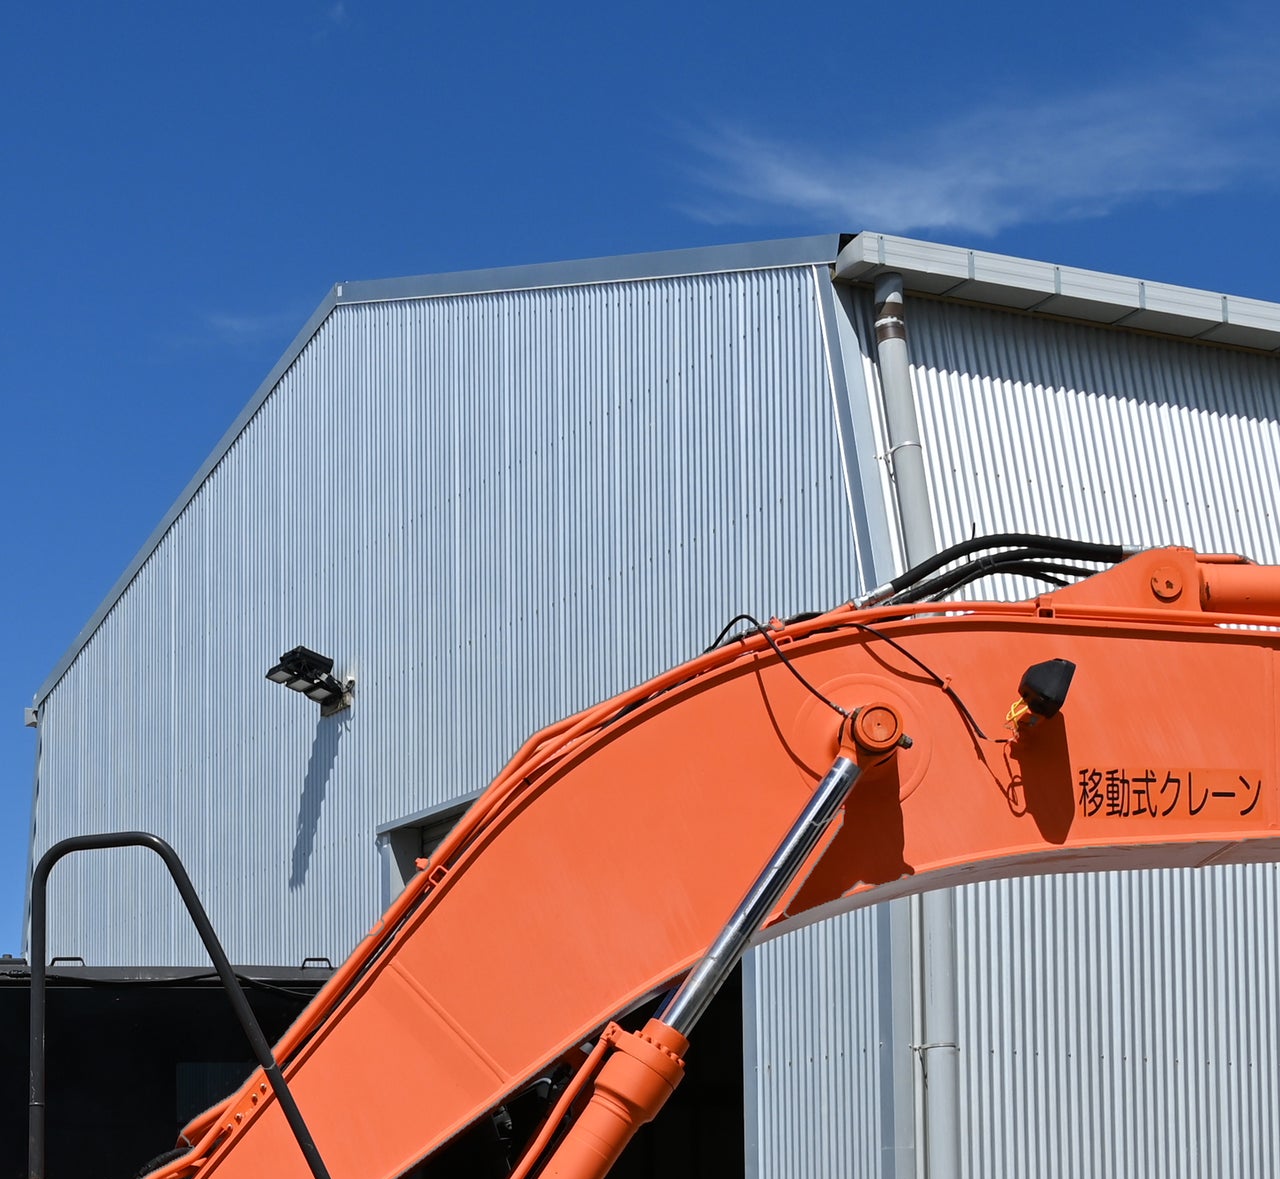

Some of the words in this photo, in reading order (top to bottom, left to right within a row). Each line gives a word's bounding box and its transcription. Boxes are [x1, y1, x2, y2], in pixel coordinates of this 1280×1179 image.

[1078, 767, 1262, 818] 移動式クレーン
